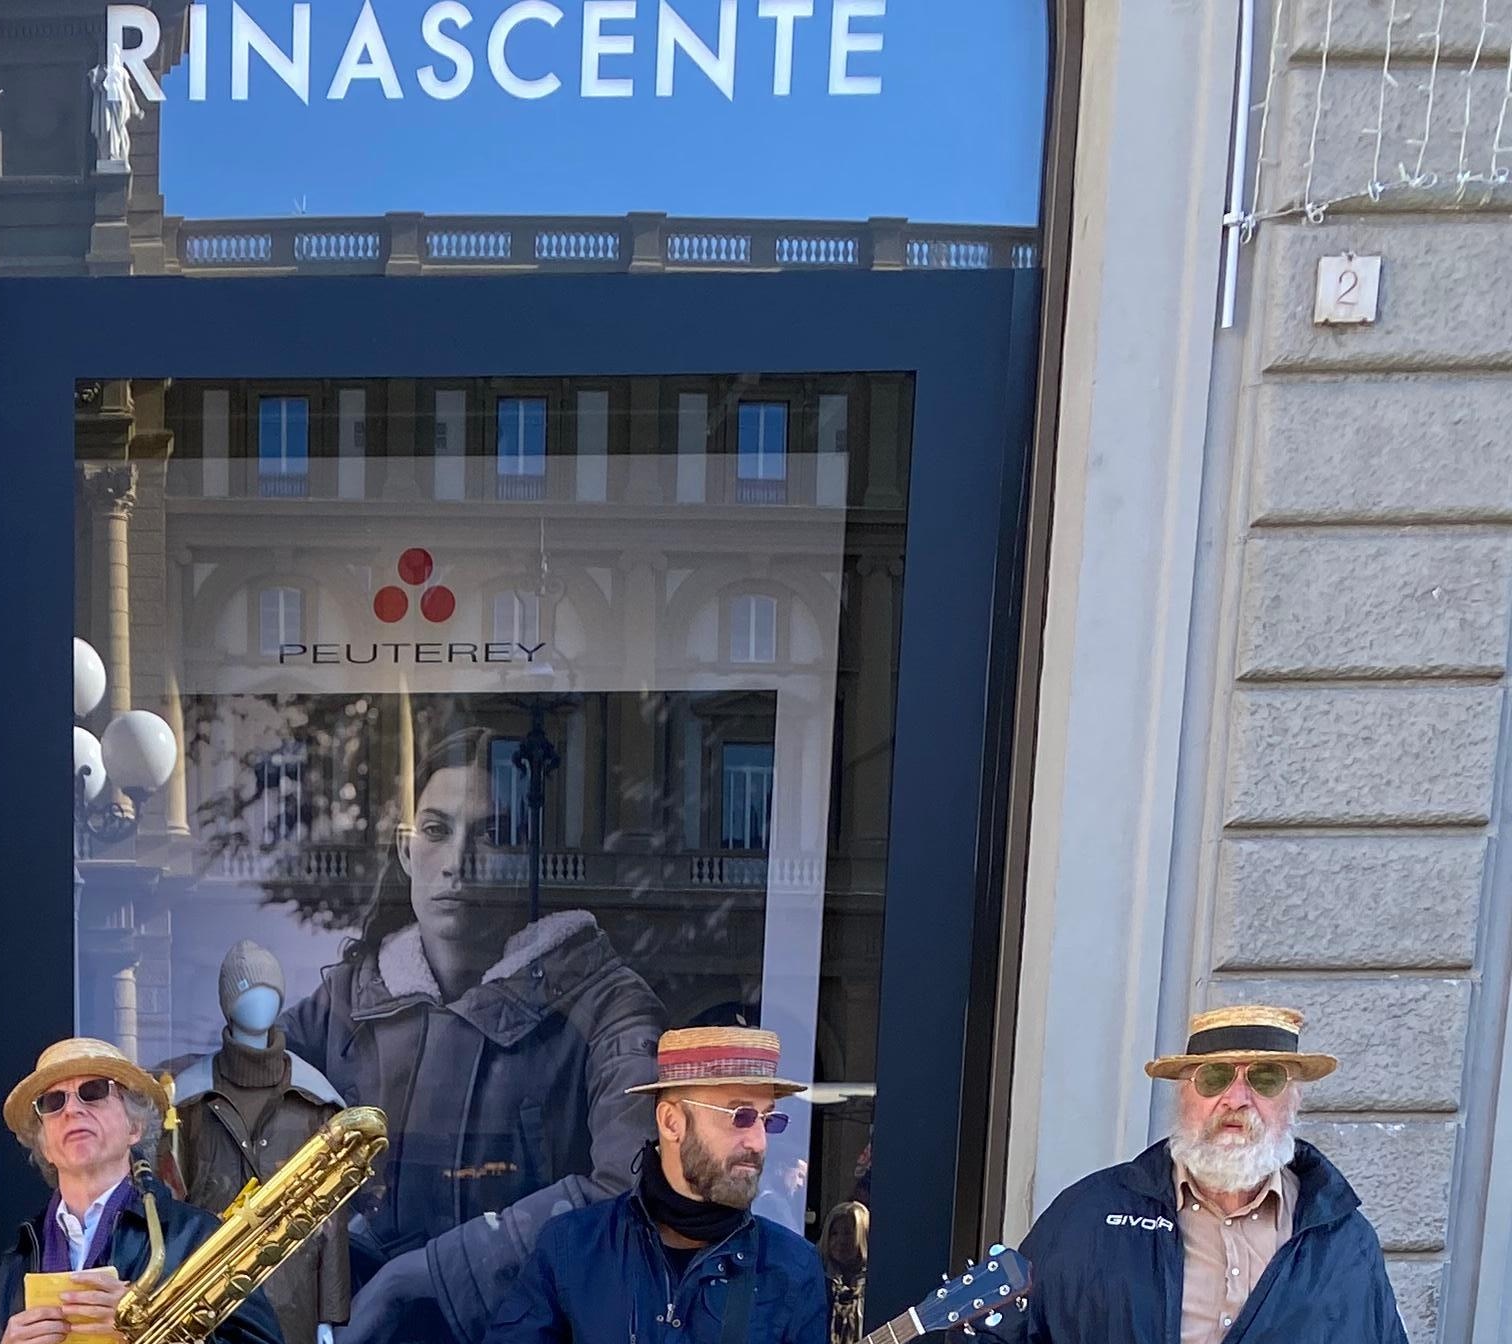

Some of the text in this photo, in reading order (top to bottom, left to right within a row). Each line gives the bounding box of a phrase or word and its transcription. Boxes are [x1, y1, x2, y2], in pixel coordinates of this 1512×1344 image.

[106, 0, 886, 105] RINASCENTE
[1337, 270, 1358, 304] 2
[279, 642, 546, 665] PEUTEREY
[1106, 1214, 1174, 1232] GIVOA
